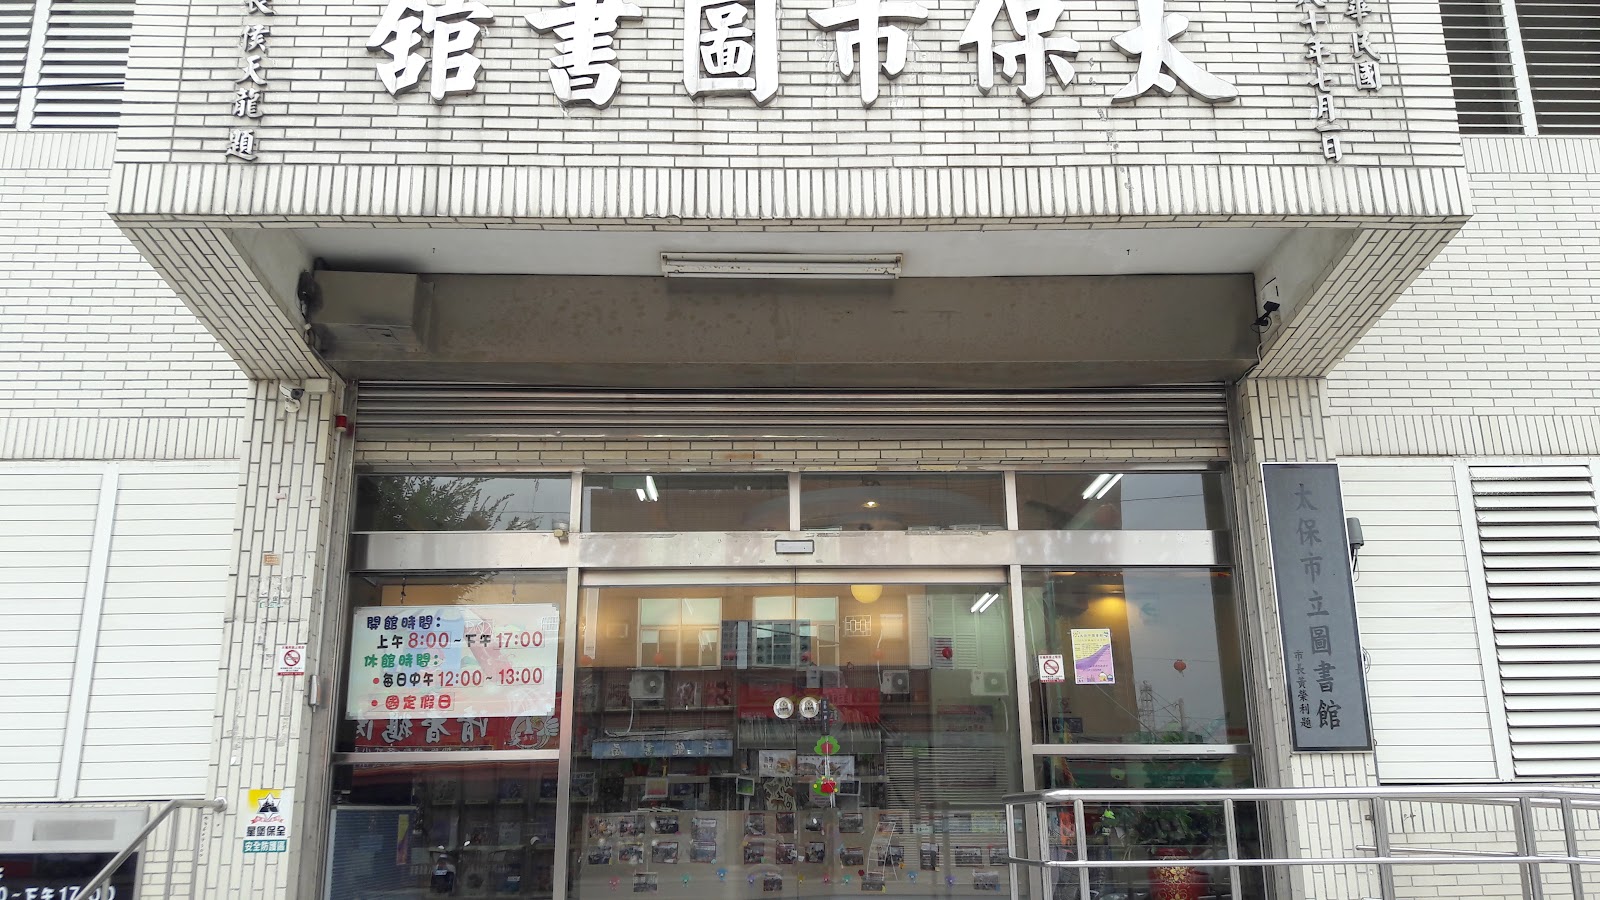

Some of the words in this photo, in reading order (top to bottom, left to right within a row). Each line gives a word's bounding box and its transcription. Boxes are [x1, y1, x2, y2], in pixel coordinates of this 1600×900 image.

[365, 0, 1239, 108] 太保市圖書館
[1296, 0, 1342, 163] 十年七月一日
[1294, 482, 1342, 730] 太保市立圖書館
[385, 694, 452, 710] 國定假日
[246, 825, 286, 837] 星堡保全
